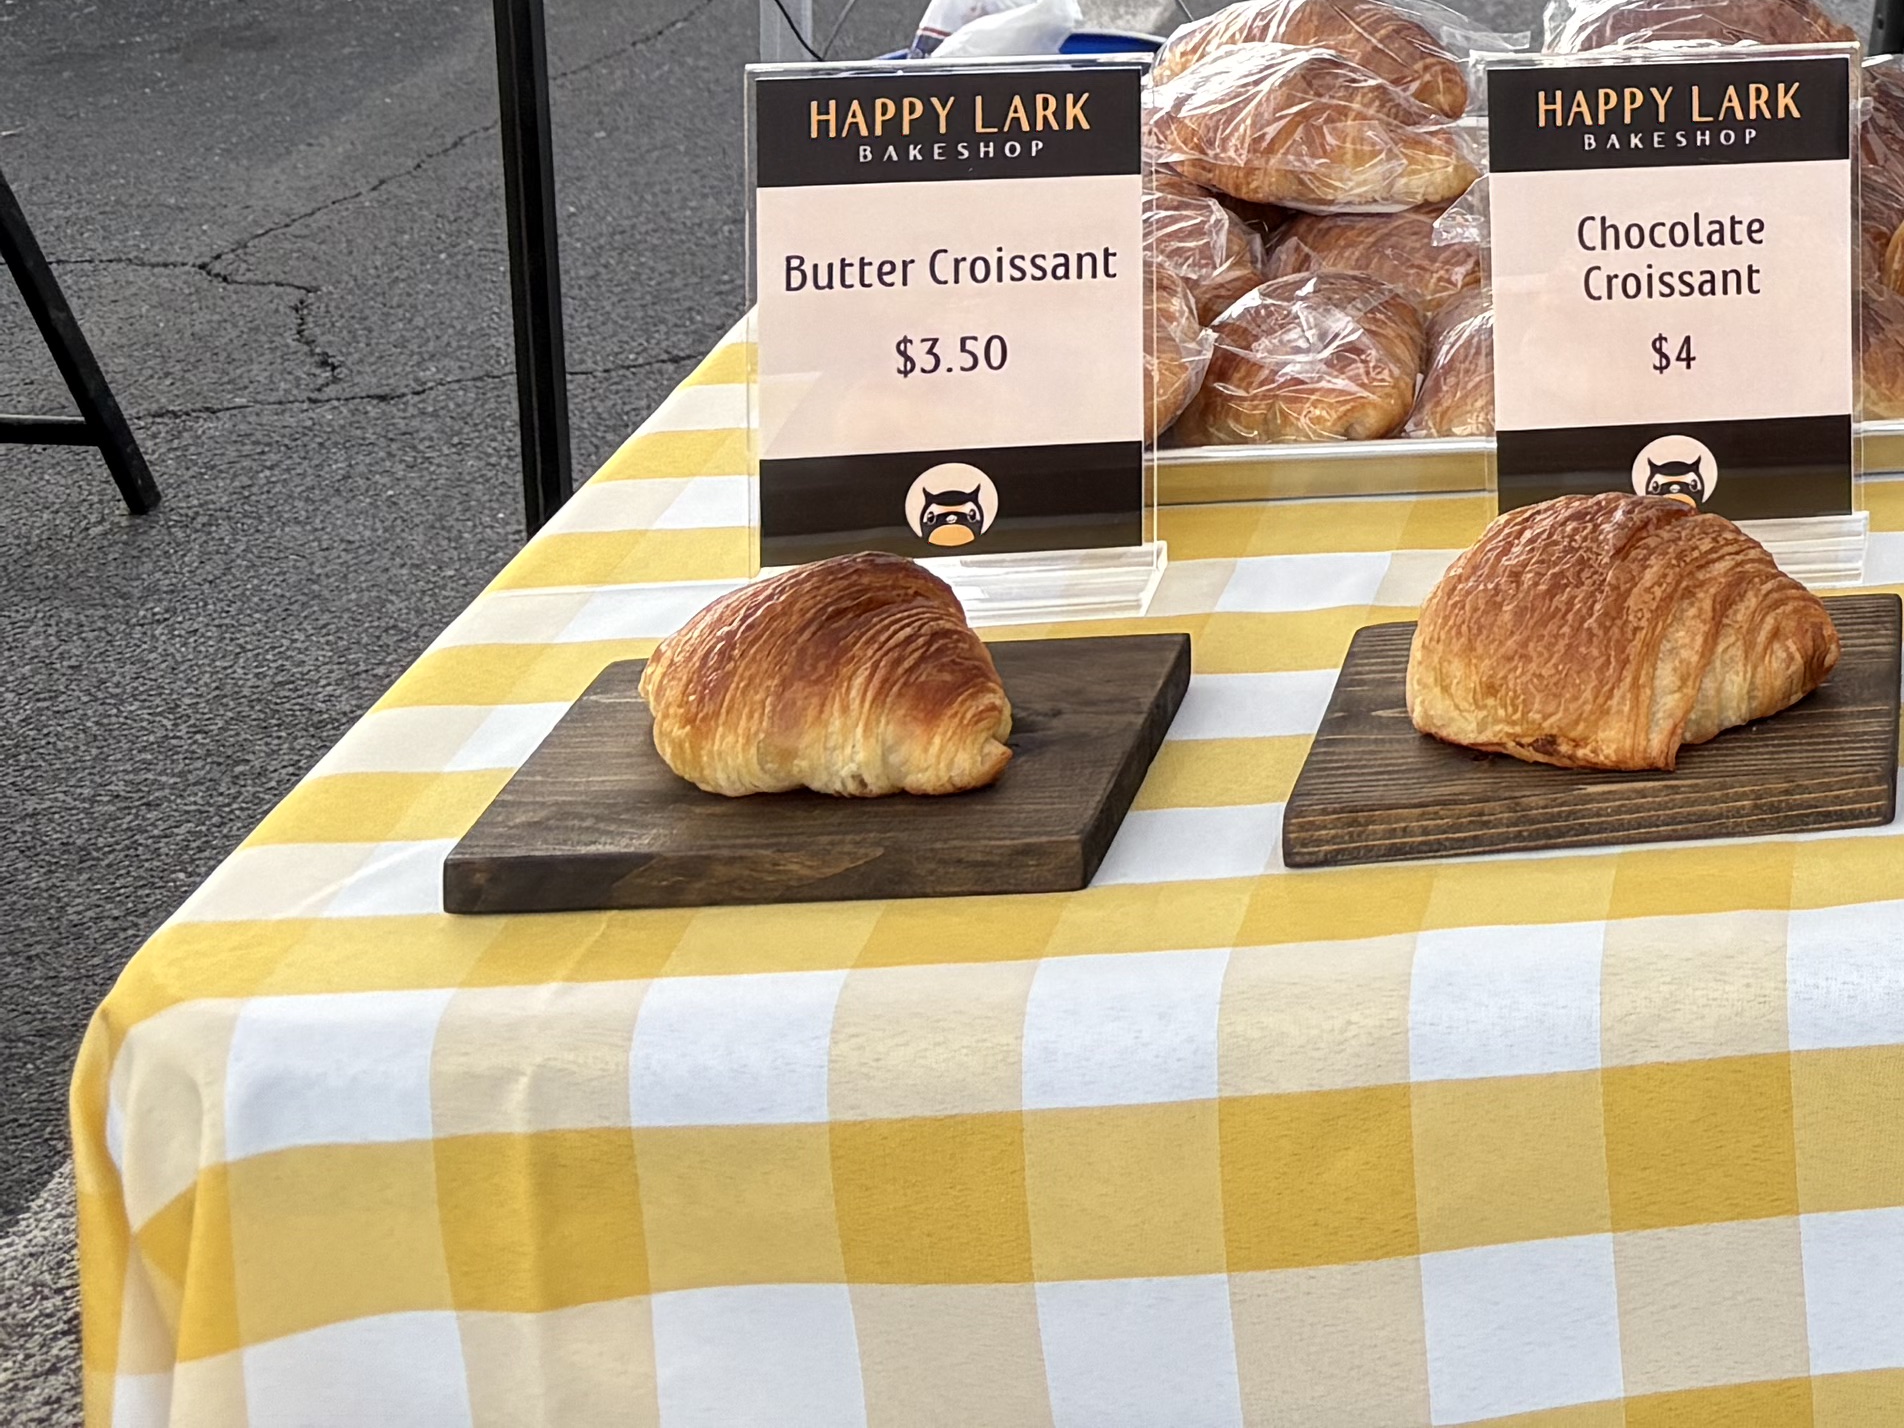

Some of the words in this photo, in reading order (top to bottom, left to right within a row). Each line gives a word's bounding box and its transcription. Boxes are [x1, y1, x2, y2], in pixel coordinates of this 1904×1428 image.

[810, 96, 955, 139] HAPPY
[975, 92, 1091, 133] LARK
[1538, 86, 1673, 128] HAPPY
[1691, 81, 1801, 122] LARK
[859, 140, 1044, 163] BAKESHOP
[1584, 128, 1757, 151] BAKESHOP
[1577, 211, 1765, 252] Chocolate
[785, 254, 916, 292] Butter
[929, 246, 1117, 285] Croissant
[1583, 263, 1761, 301] Croissant
[895, 334, 1008, 379] $3.50
[1651, 332, 1697, 375] $4
